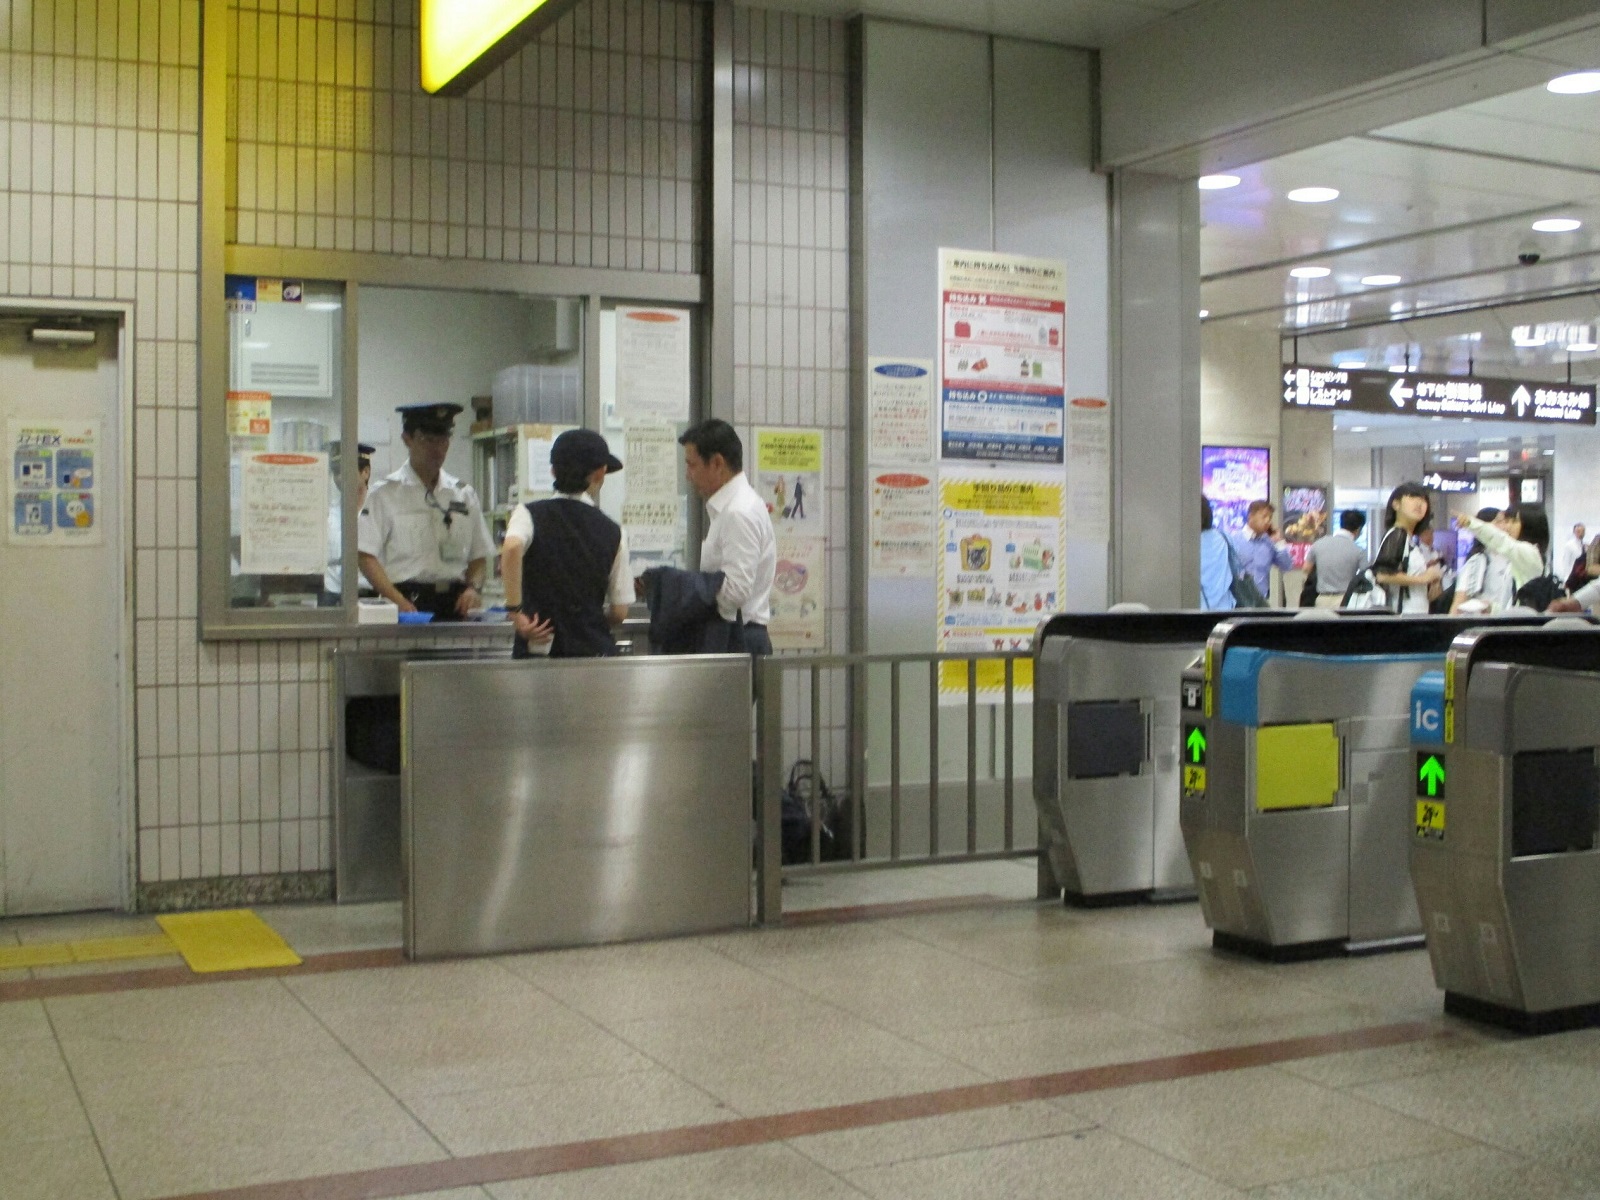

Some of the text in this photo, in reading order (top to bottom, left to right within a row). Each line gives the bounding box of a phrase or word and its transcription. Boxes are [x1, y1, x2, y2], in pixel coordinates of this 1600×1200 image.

[1534, 389, 1590, 409] あおなみ線
[1488, 401, 1505, 414] Line
[1535, 405, 1581, 419] Aonami Line
